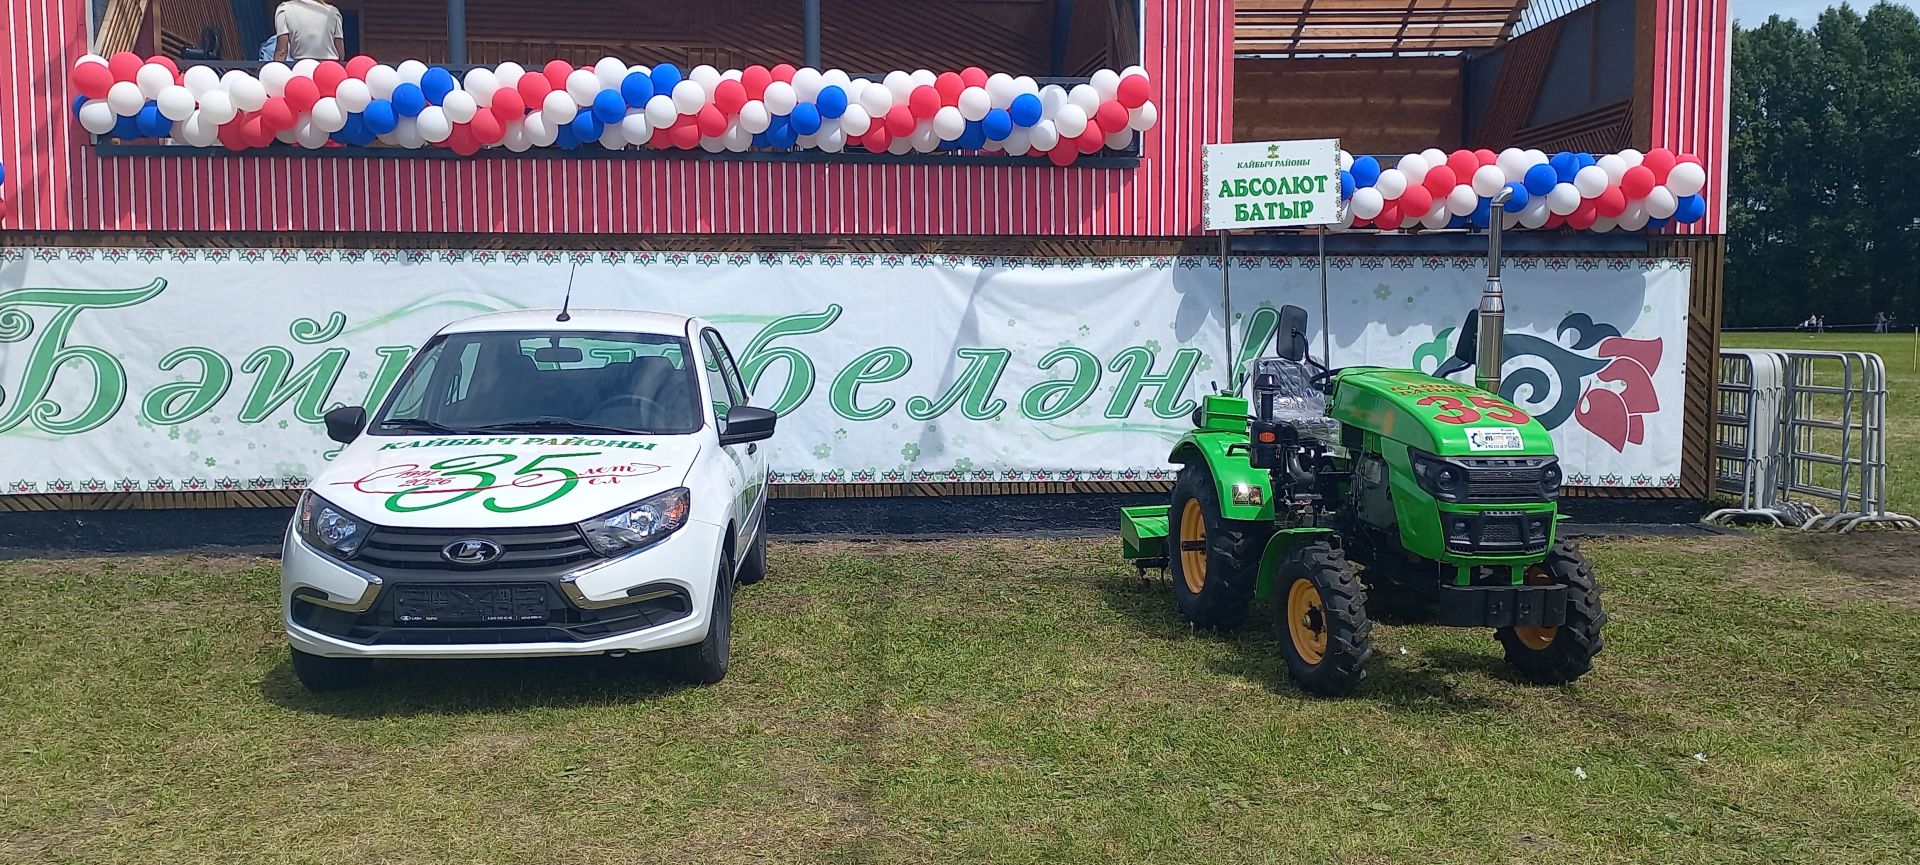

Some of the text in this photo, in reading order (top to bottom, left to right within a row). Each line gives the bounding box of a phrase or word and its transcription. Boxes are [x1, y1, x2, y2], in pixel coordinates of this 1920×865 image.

[1237, 158, 1310, 169] КАЙБЫЧ РАЙОНЫ
[1218, 175, 1328, 198] АБСОЛЮТ
[1235, 200, 1314, 221] БАТЫР
[1416, 395, 1531, 424] 35
[378, 436, 658, 451] КАЙБЫЧ РАЙОНЫ
[384, 452, 602, 513] 35
